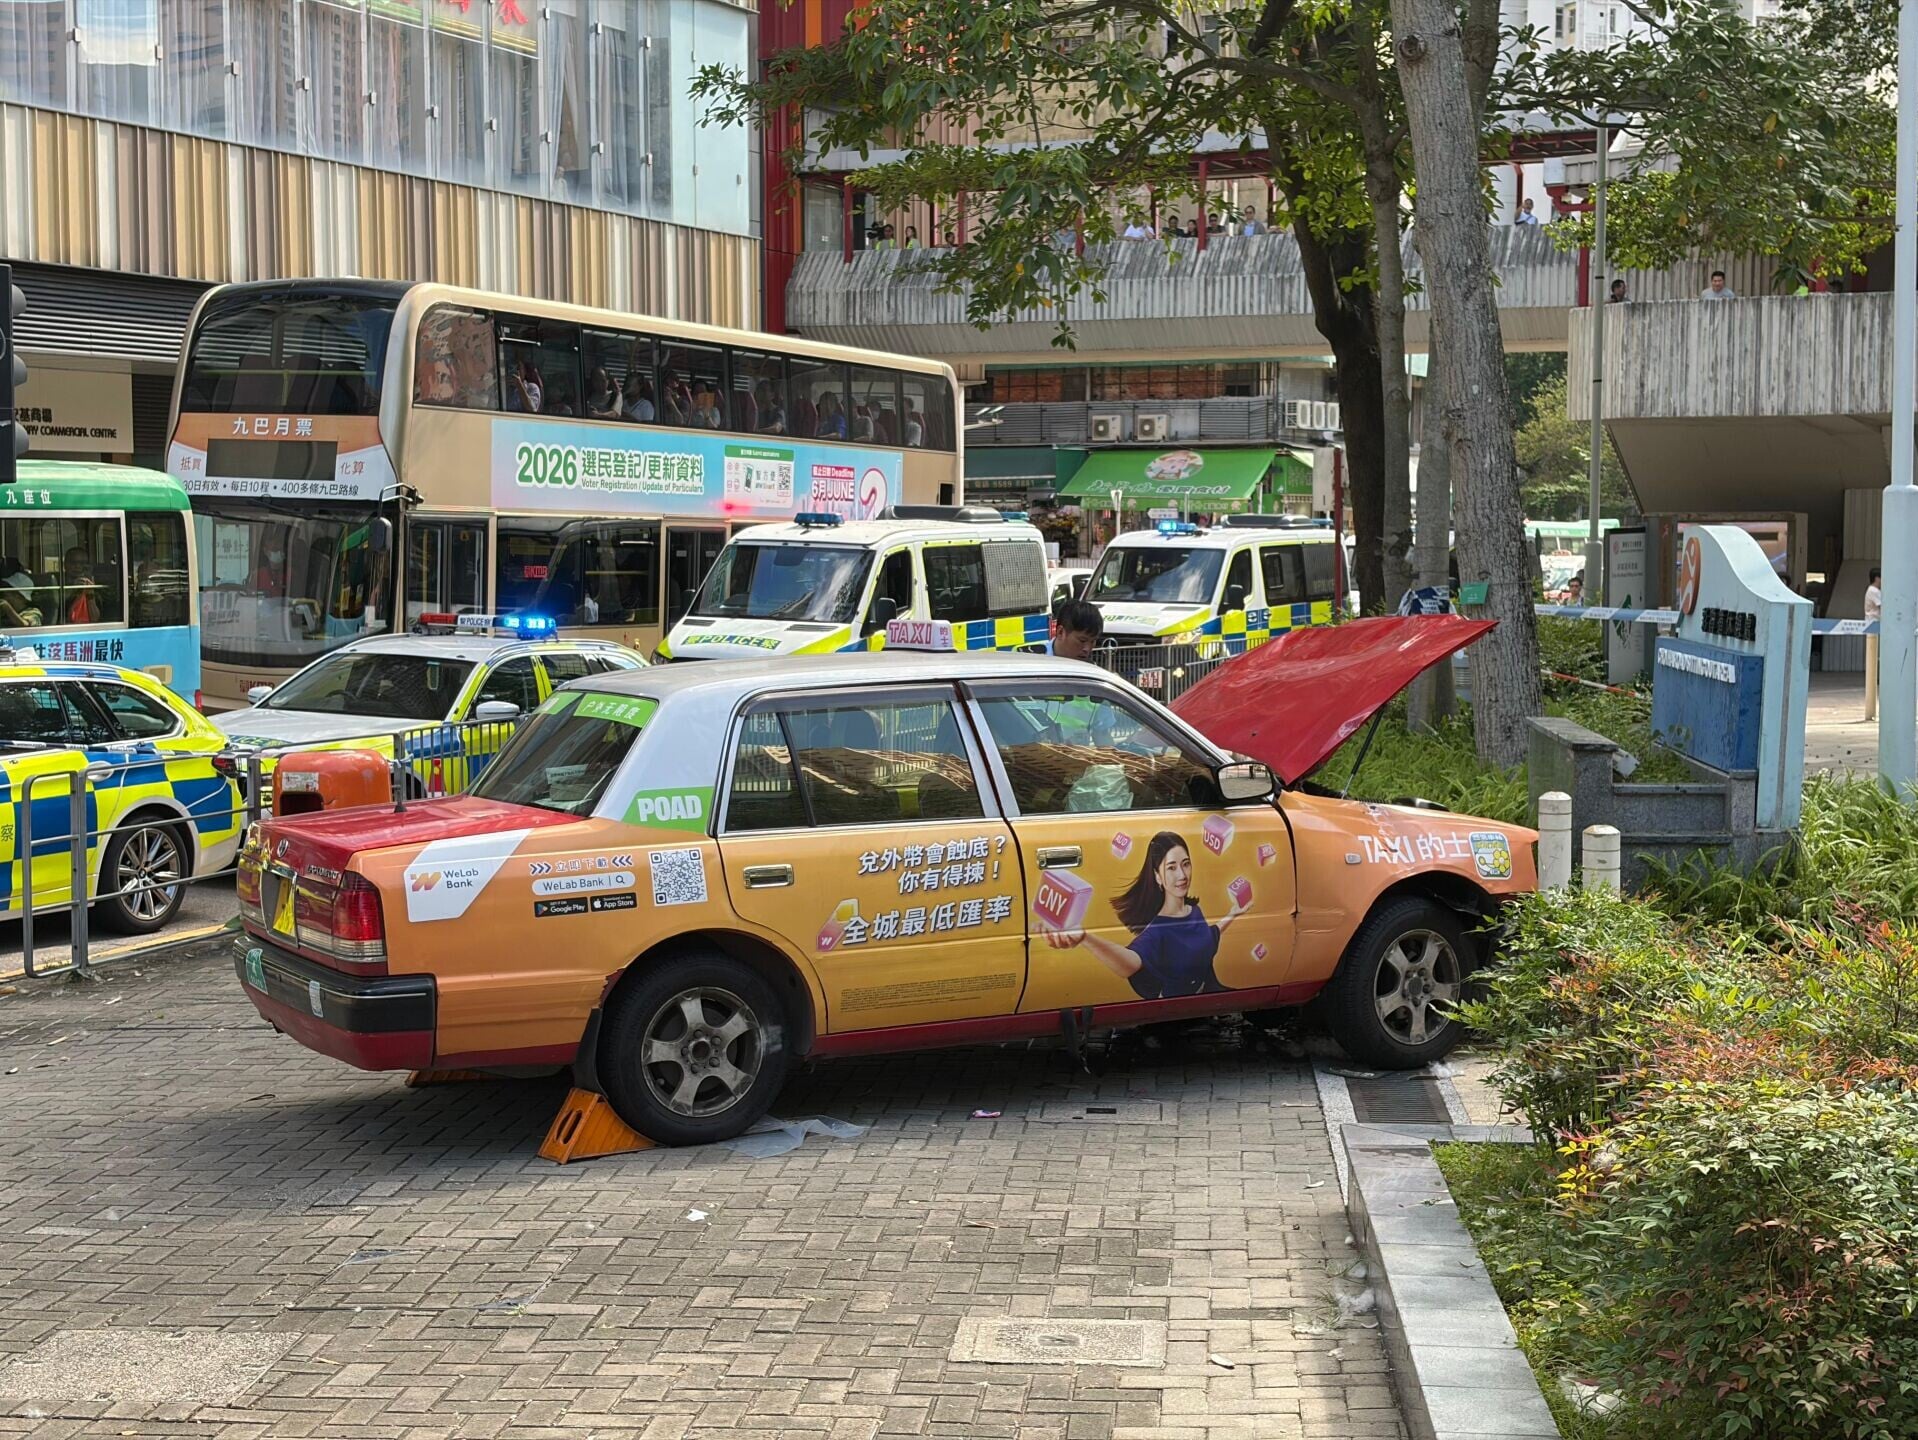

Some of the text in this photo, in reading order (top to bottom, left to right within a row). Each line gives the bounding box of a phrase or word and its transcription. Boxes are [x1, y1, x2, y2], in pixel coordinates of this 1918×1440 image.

[90, 428, 117, 439] CENTRE
[232, 416, 313, 436] 九巴月票
[517, 446, 703, 486] 2026 選民登記/更新資料
[230, 481, 270, 493] 每日10程
[581, 477, 600, 489] Voter
[600, 479, 638, 492] Registration
[642, 482, 664, 494] Update
[672, 484, 703, 494] Particulars
[889, 622, 932, 645] TAXI
[637, 795, 703, 822] POAD
[1204, 829, 1221, 850] USD
[1357, 831, 1471, 864] TAXI 的士
[443, 868, 479, 879] WeLab
[446, 879, 473, 889] Bank
[542, 878, 604, 891] WeLab Bank
[550, 904, 585, 914] Google Play
[603, 900, 635, 909] App Store
[1038, 884, 1068, 917] CNY
[842, 895, 1012, 946] 全城最低匯率
